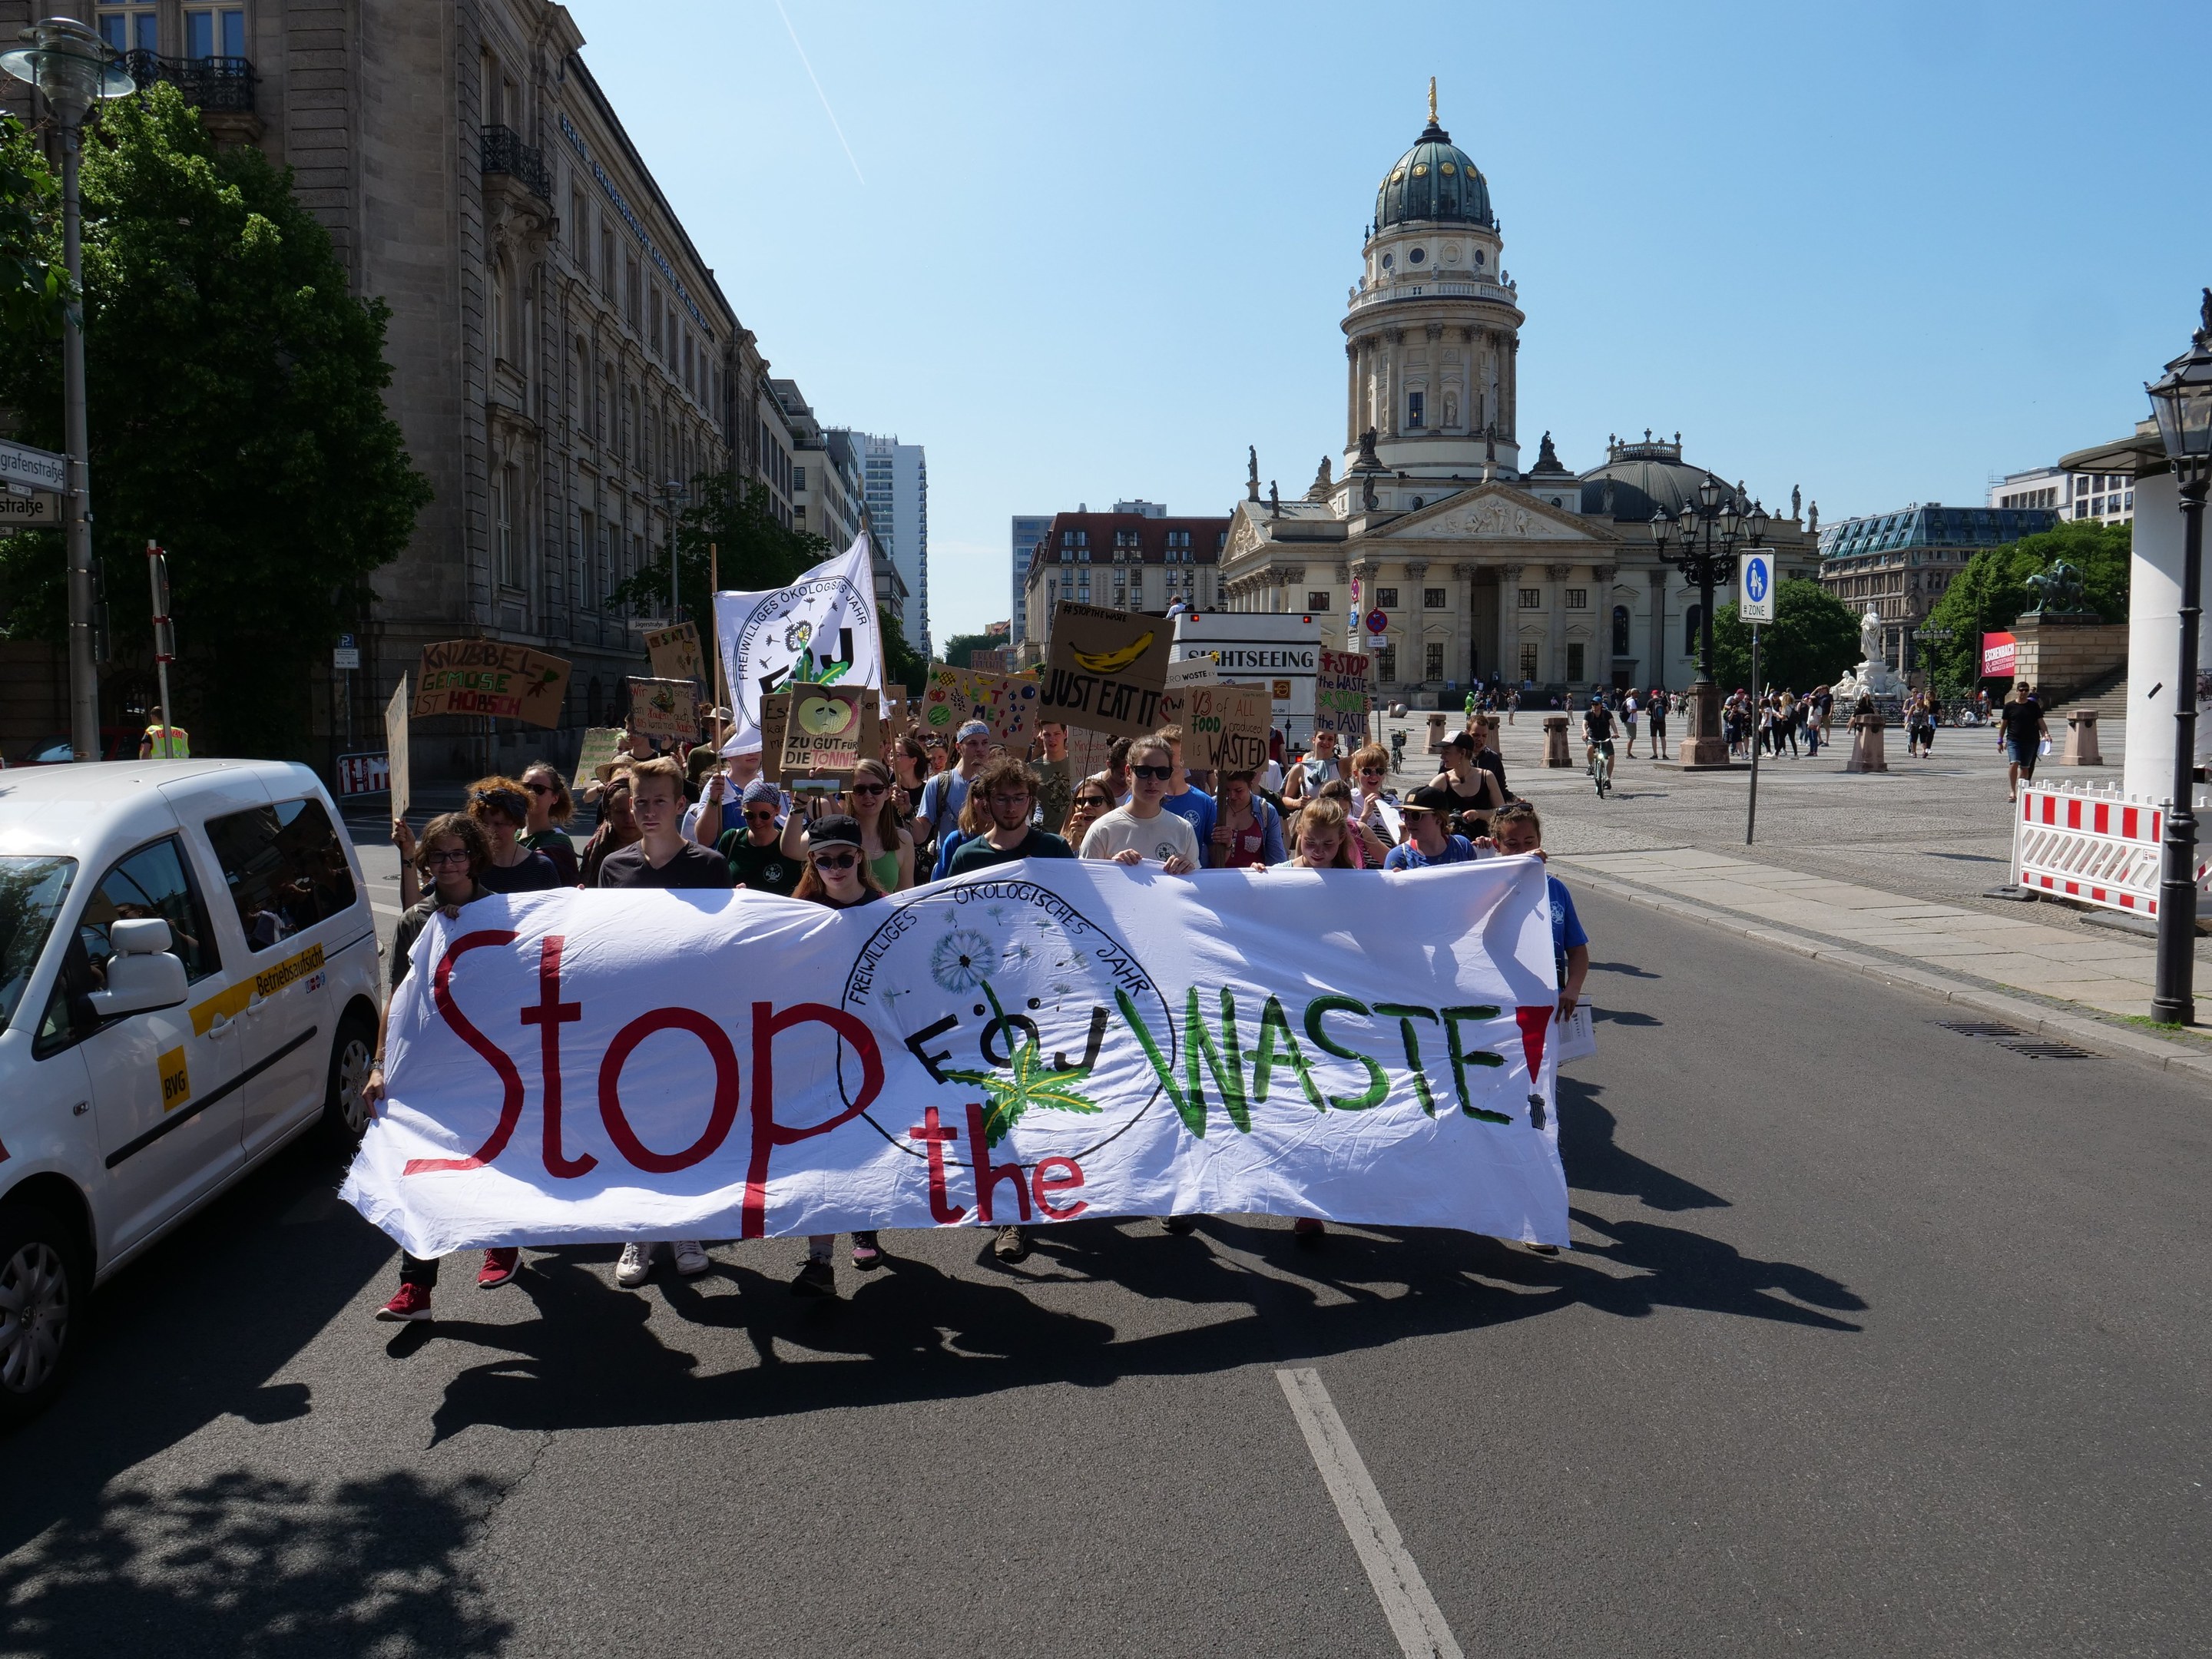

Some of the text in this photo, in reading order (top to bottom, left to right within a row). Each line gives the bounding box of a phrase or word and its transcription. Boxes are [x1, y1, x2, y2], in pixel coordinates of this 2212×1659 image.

[0, 453, 64, 482] grafenstraße
[1749, 604, 1765, 616] ZONE
[739, 600, 779, 680] FREIWILLIGES
[846, 594, 867, 625] JAHR
[423, 642, 545, 678] KNUBBEL-
[1334, 653, 1369, 677] STOP
[1985, 643, 2015, 663] ESCHENBACH
[422, 671, 512, 693] GEMÜSE
[630, 684, 648, 697] Wir
[1165, 674, 1181, 684] ERO
[1319, 675, 1368, 693] the WASTE
[413, 690, 522, 715] IST HÜBSCH
[971, 687, 1004, 705] EAT
[1040, 669, 1100, 711] JUST
[1097, 680, 1139, 721] EAT
[1137, 690, 1162, 727] IT
[1336, 690, 1368, 714] START
[972, 704, 996, 721] ME
[1216, 697, 1230, 721] of
[1234, 699, 1255, 717] ALL
[1191, 715, 1263, 734] FOOD produced
[1317, 711, 1367, 734] the TASTE
[788, 737, 858, 750] ZU GUT FÜR
[1193, 726, 1267, 771] is WASTED
[785, 750, 859, 767] DIE TONNE
[1076, 764, 1101, 777] NIHT
[847, 883, 1151, 1005] FREIWILLIGES ÖKOLOGISCHES JAHR
[256, 946, 324, 997] Betriebsaufsicht
[164, 1070, 186, 1100] BVG
[402, 928, 885, 1240] Stop
[909, 1103, 1088, 1225] the
